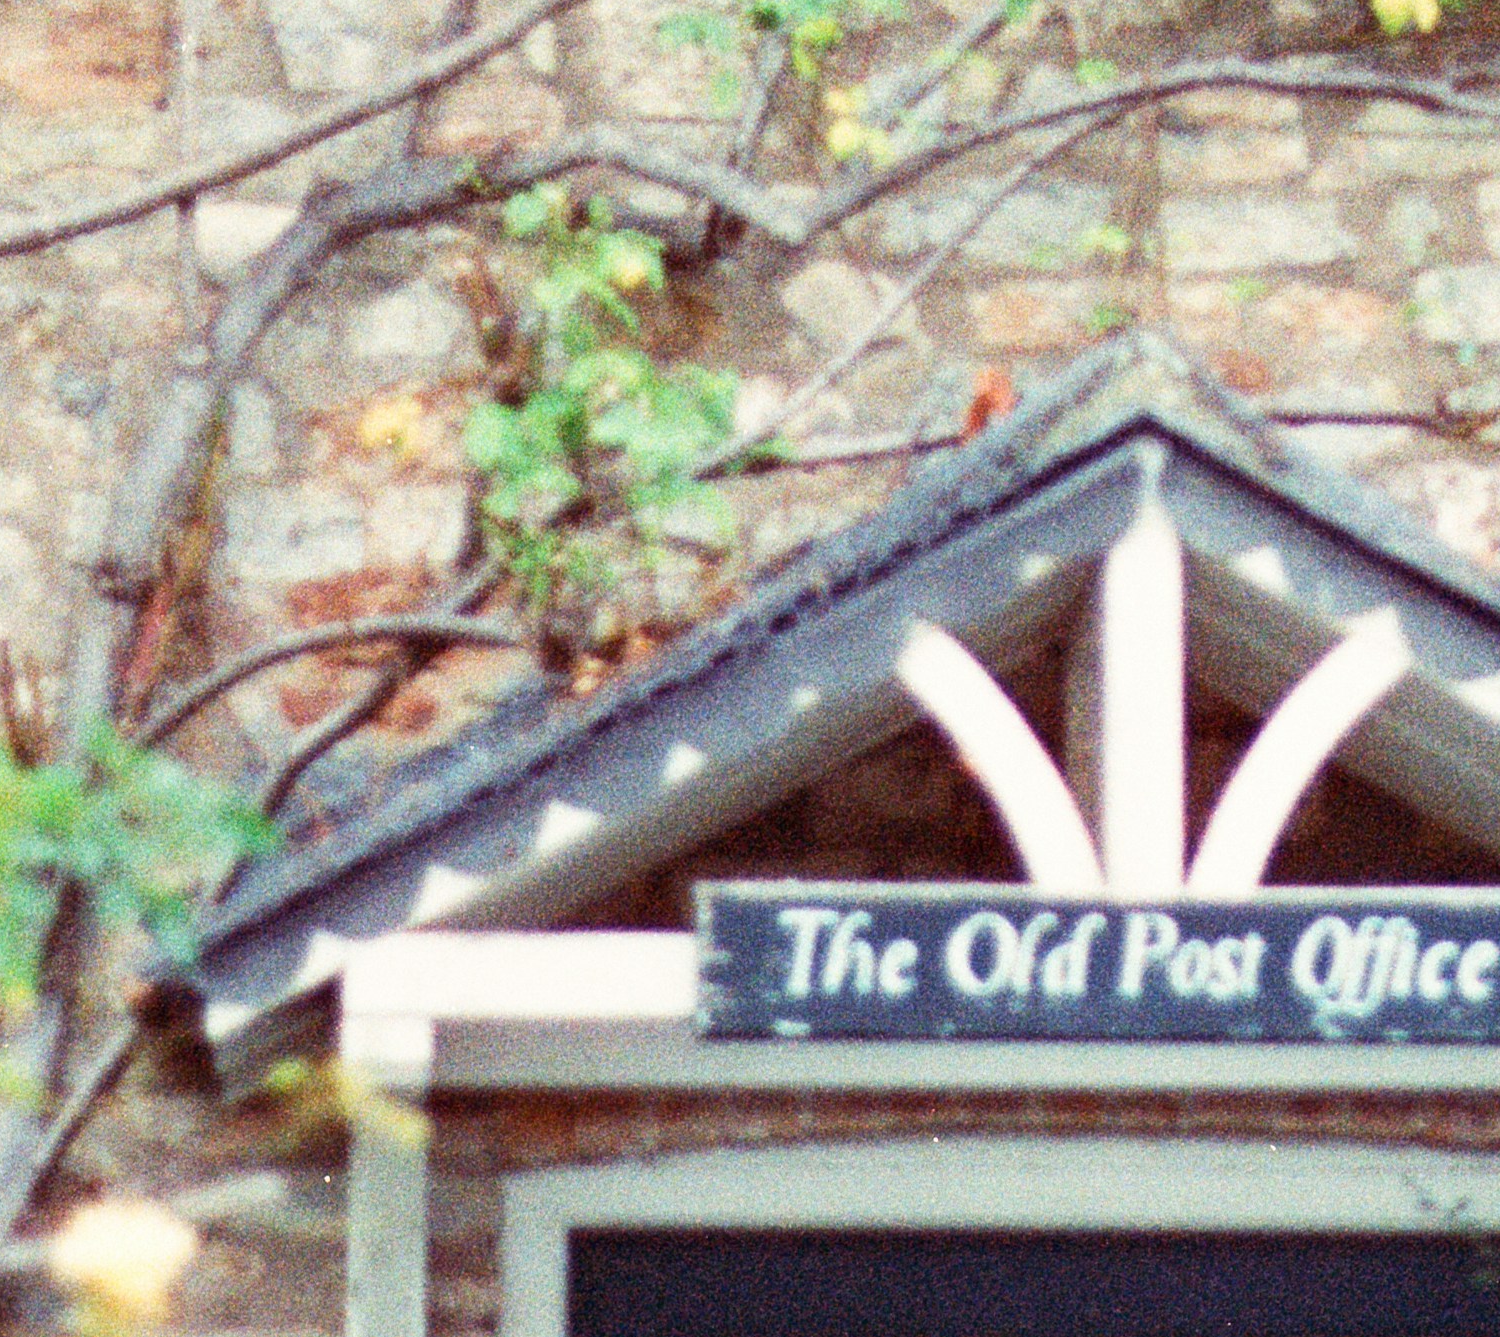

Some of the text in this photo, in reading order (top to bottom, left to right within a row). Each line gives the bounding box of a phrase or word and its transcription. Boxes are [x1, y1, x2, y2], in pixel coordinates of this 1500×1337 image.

[776, 906, 1500, 1016] The Old Post Office
